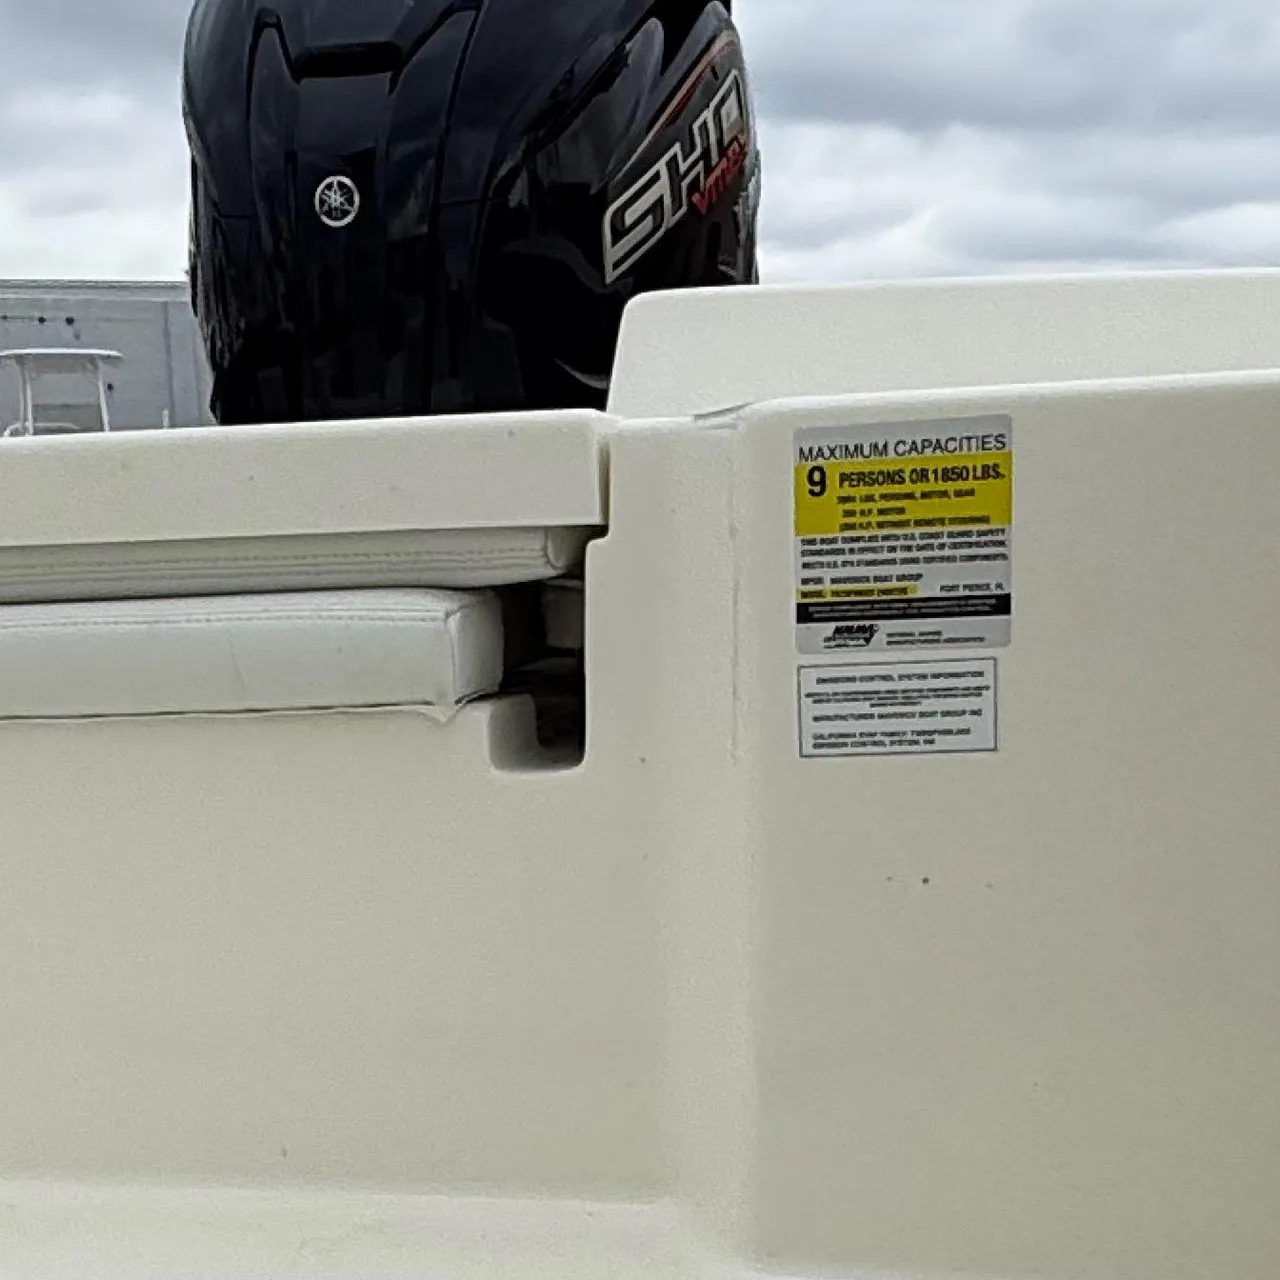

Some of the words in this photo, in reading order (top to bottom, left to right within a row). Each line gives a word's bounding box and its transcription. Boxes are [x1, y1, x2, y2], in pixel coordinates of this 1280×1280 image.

[798, 439, 888, 462] MAXIMUM
[893, 433, 1006, 457] CAPACITIES
[806, 465, 827, 497] 9
[838, 468, 906, 488] PERSONS
[909, 467, 930, 484] OR
[972, 463, 1005, 481] LBS.
